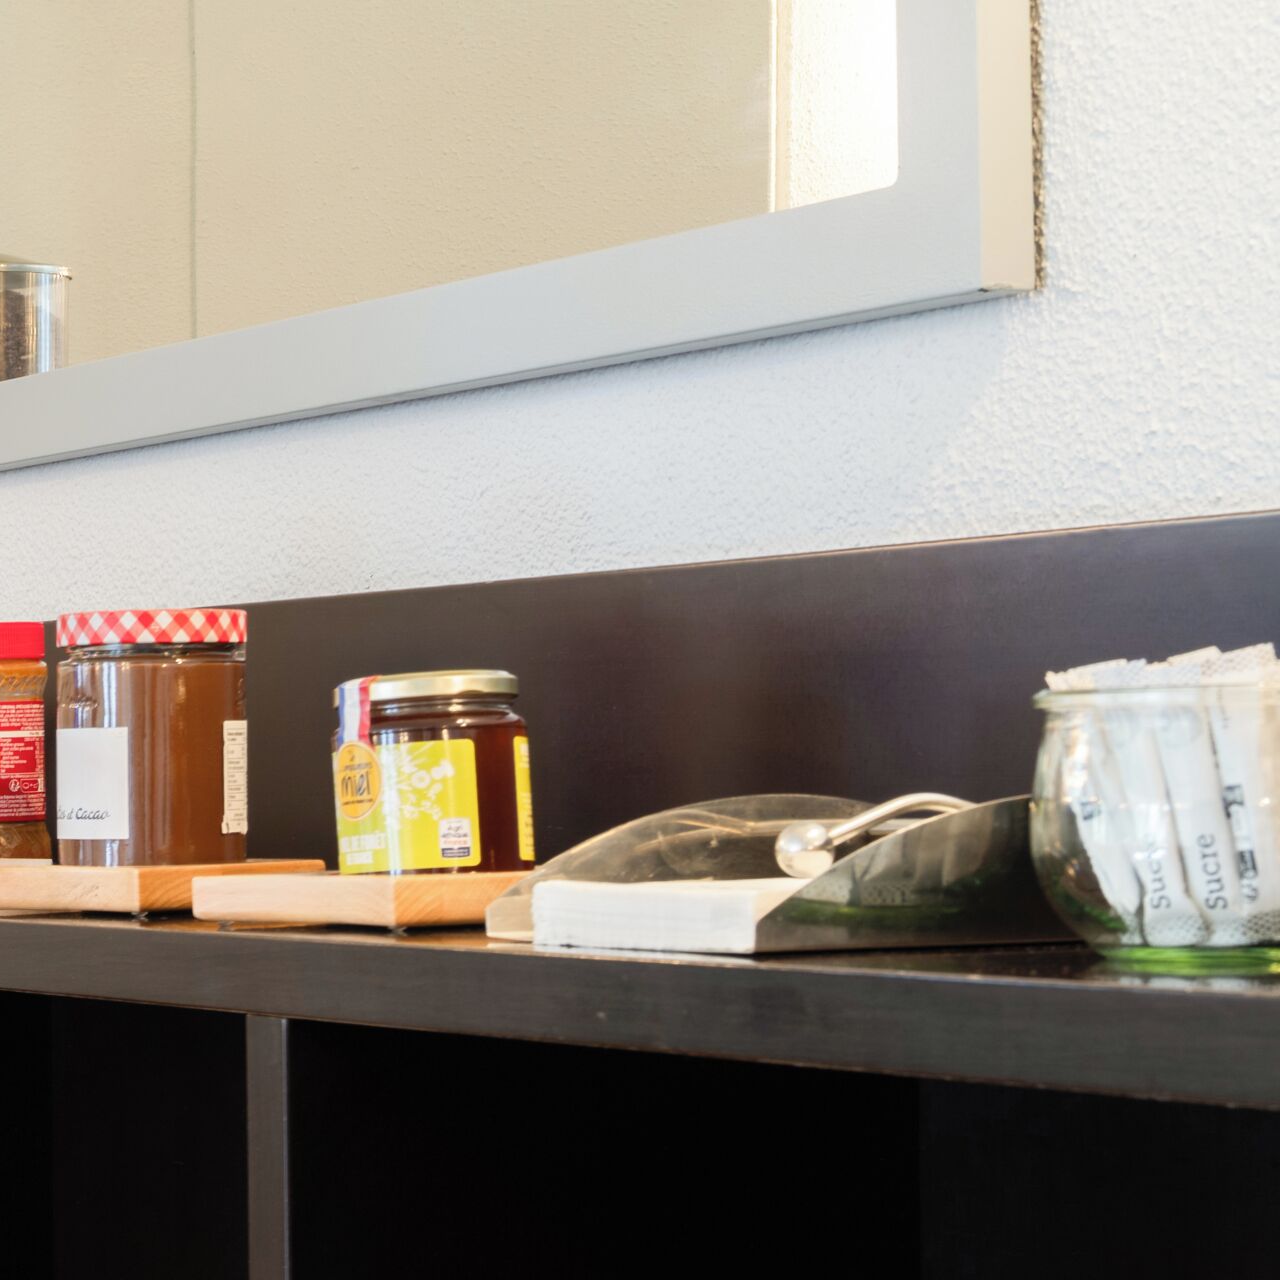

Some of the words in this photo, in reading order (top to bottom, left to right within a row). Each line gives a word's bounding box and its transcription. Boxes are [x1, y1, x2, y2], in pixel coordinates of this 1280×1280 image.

[341, 771, 371, 797] miel
[76, 807, 111, 820] Cacao
[1197, 833, 1228, 910] Sucre
